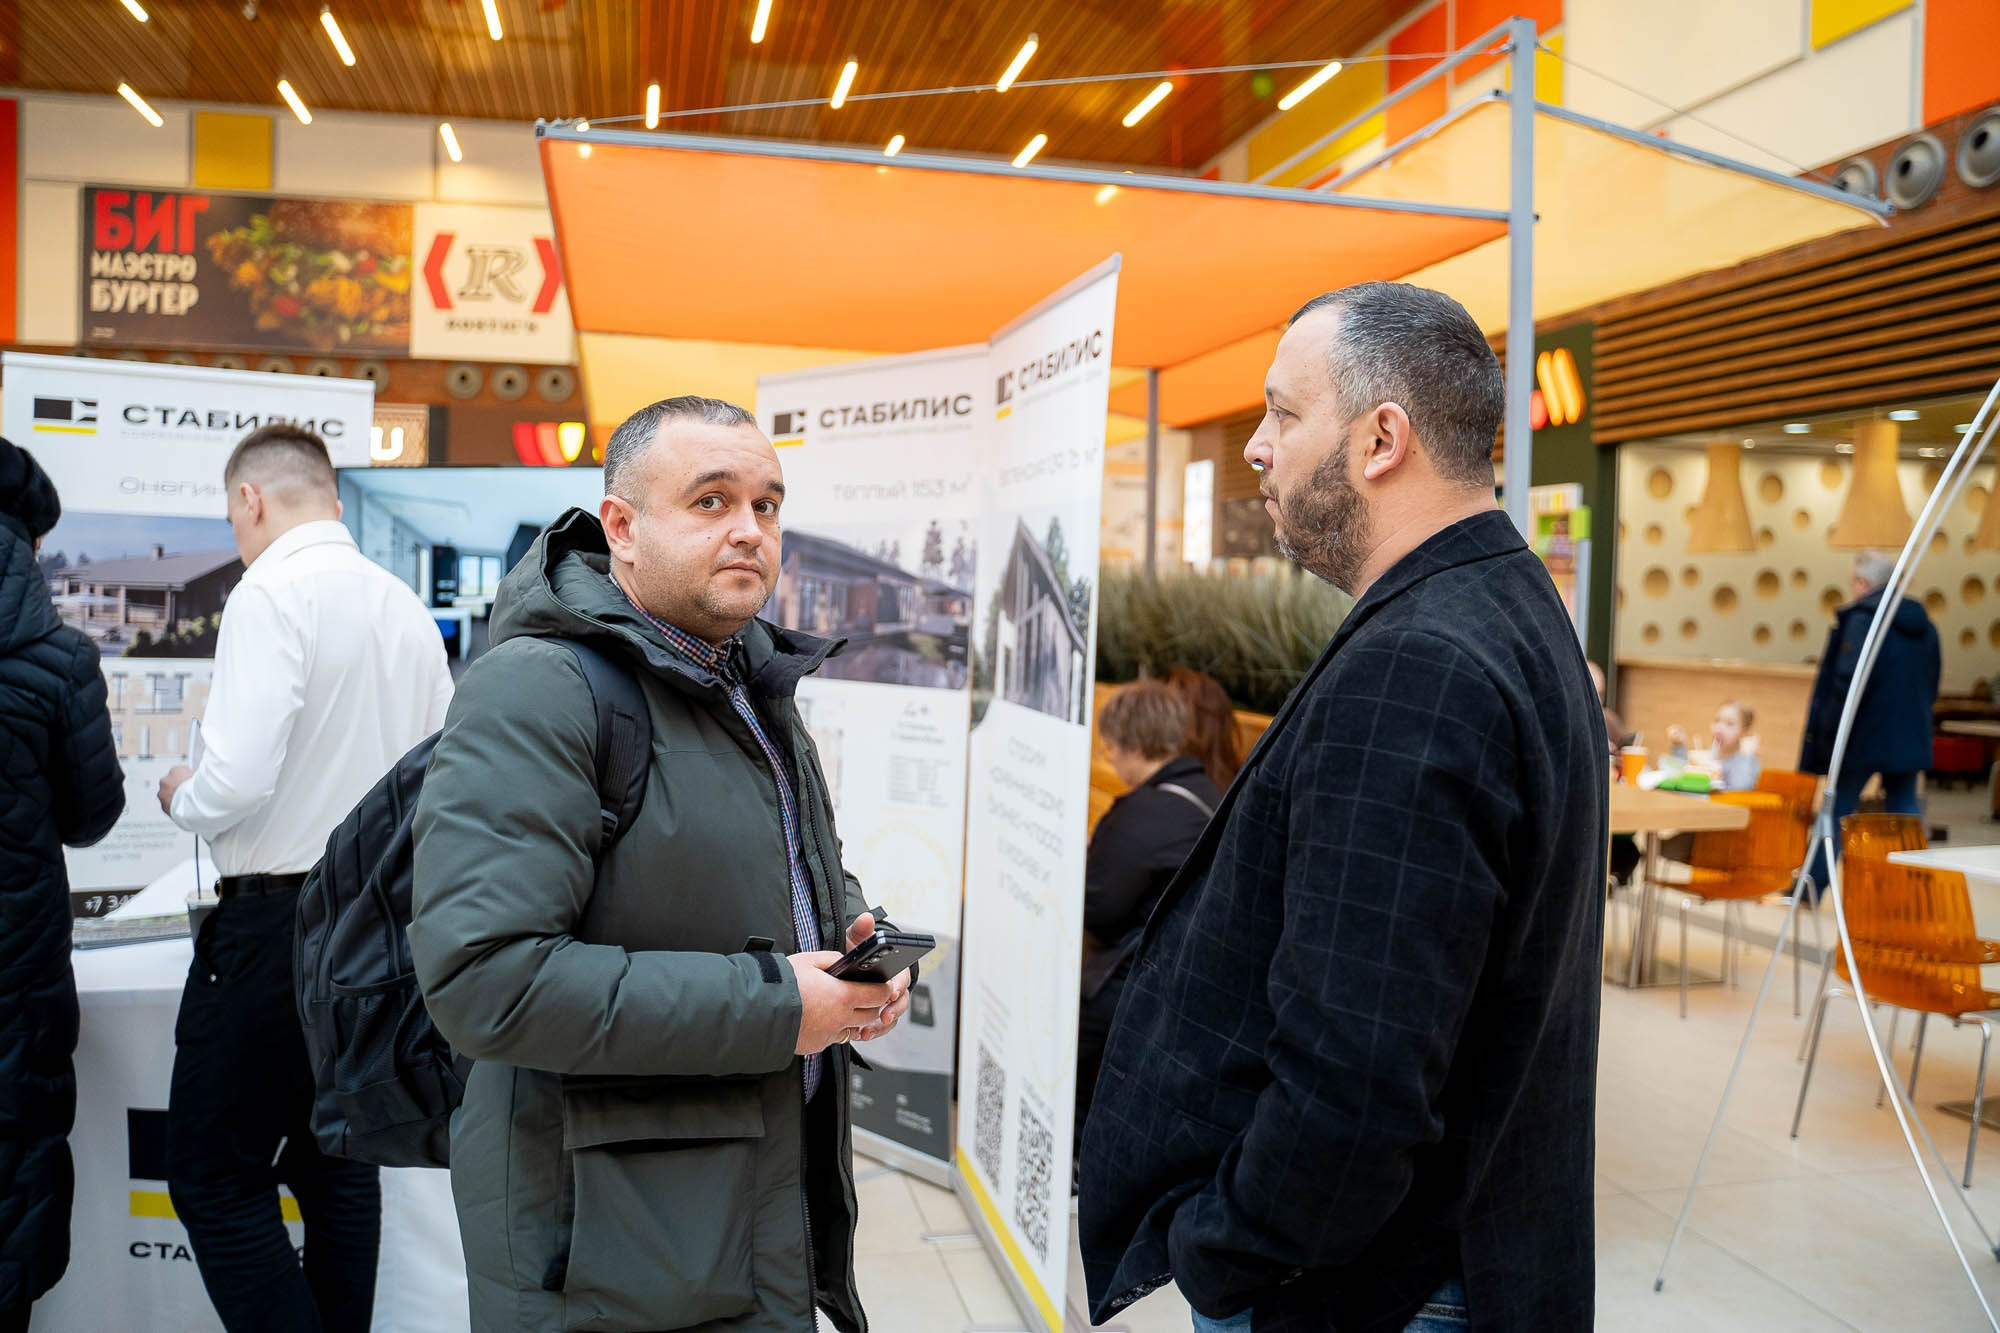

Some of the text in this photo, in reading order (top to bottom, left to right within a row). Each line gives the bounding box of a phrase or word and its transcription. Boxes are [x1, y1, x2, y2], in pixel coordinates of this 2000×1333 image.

[94, 190, 210, 254] БИГ
[91, 251, 197, 282] МАЭСТРО
[90, 279, 200, 316] БУРГЕР
[819, 393, 972, 429] СТАБИЛИС
